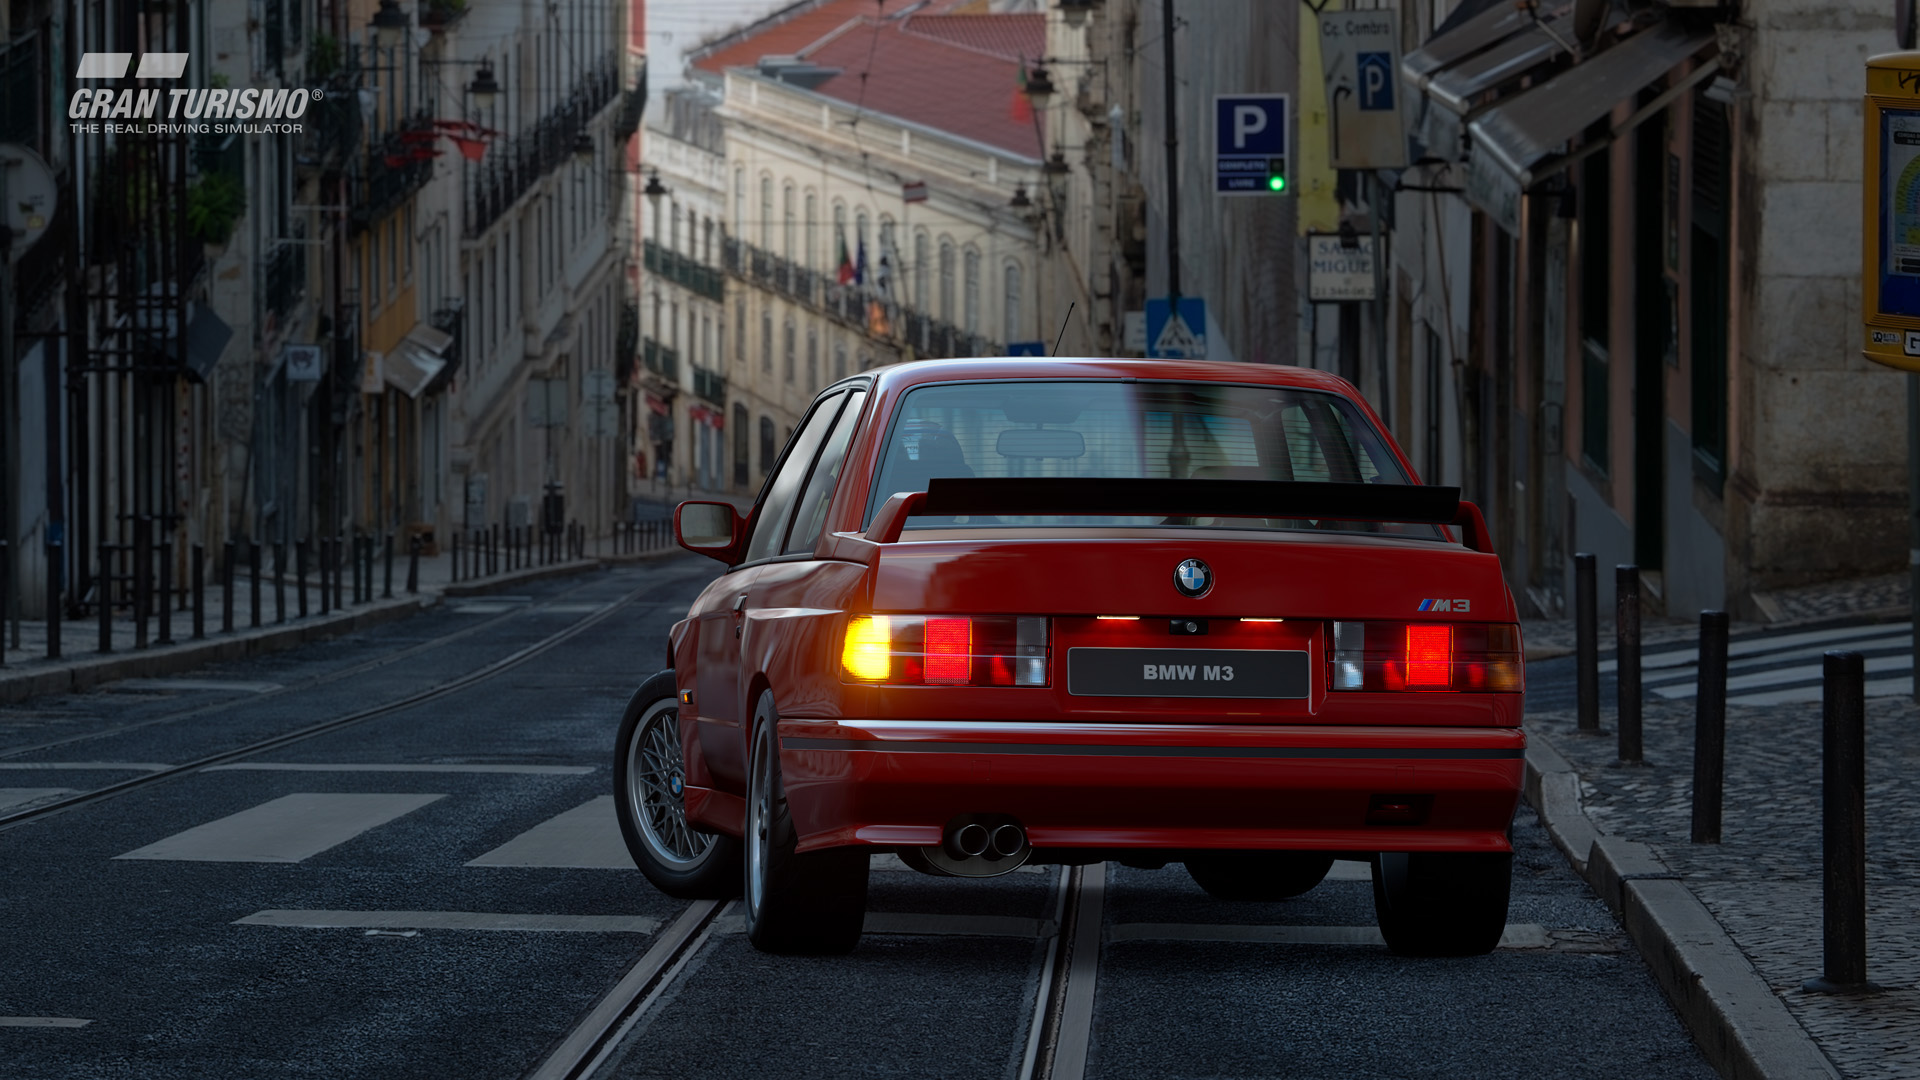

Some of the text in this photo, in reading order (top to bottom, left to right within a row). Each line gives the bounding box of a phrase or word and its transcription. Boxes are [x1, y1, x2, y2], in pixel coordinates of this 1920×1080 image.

[1365, 64, 1385, 107] P
[1233, 104, 1268, 149] P
[1178, 560, 1209, 574] BMW
[1430, 598, 1471, 613] M3
[1143, 664, 1235, 681] BMW M3
